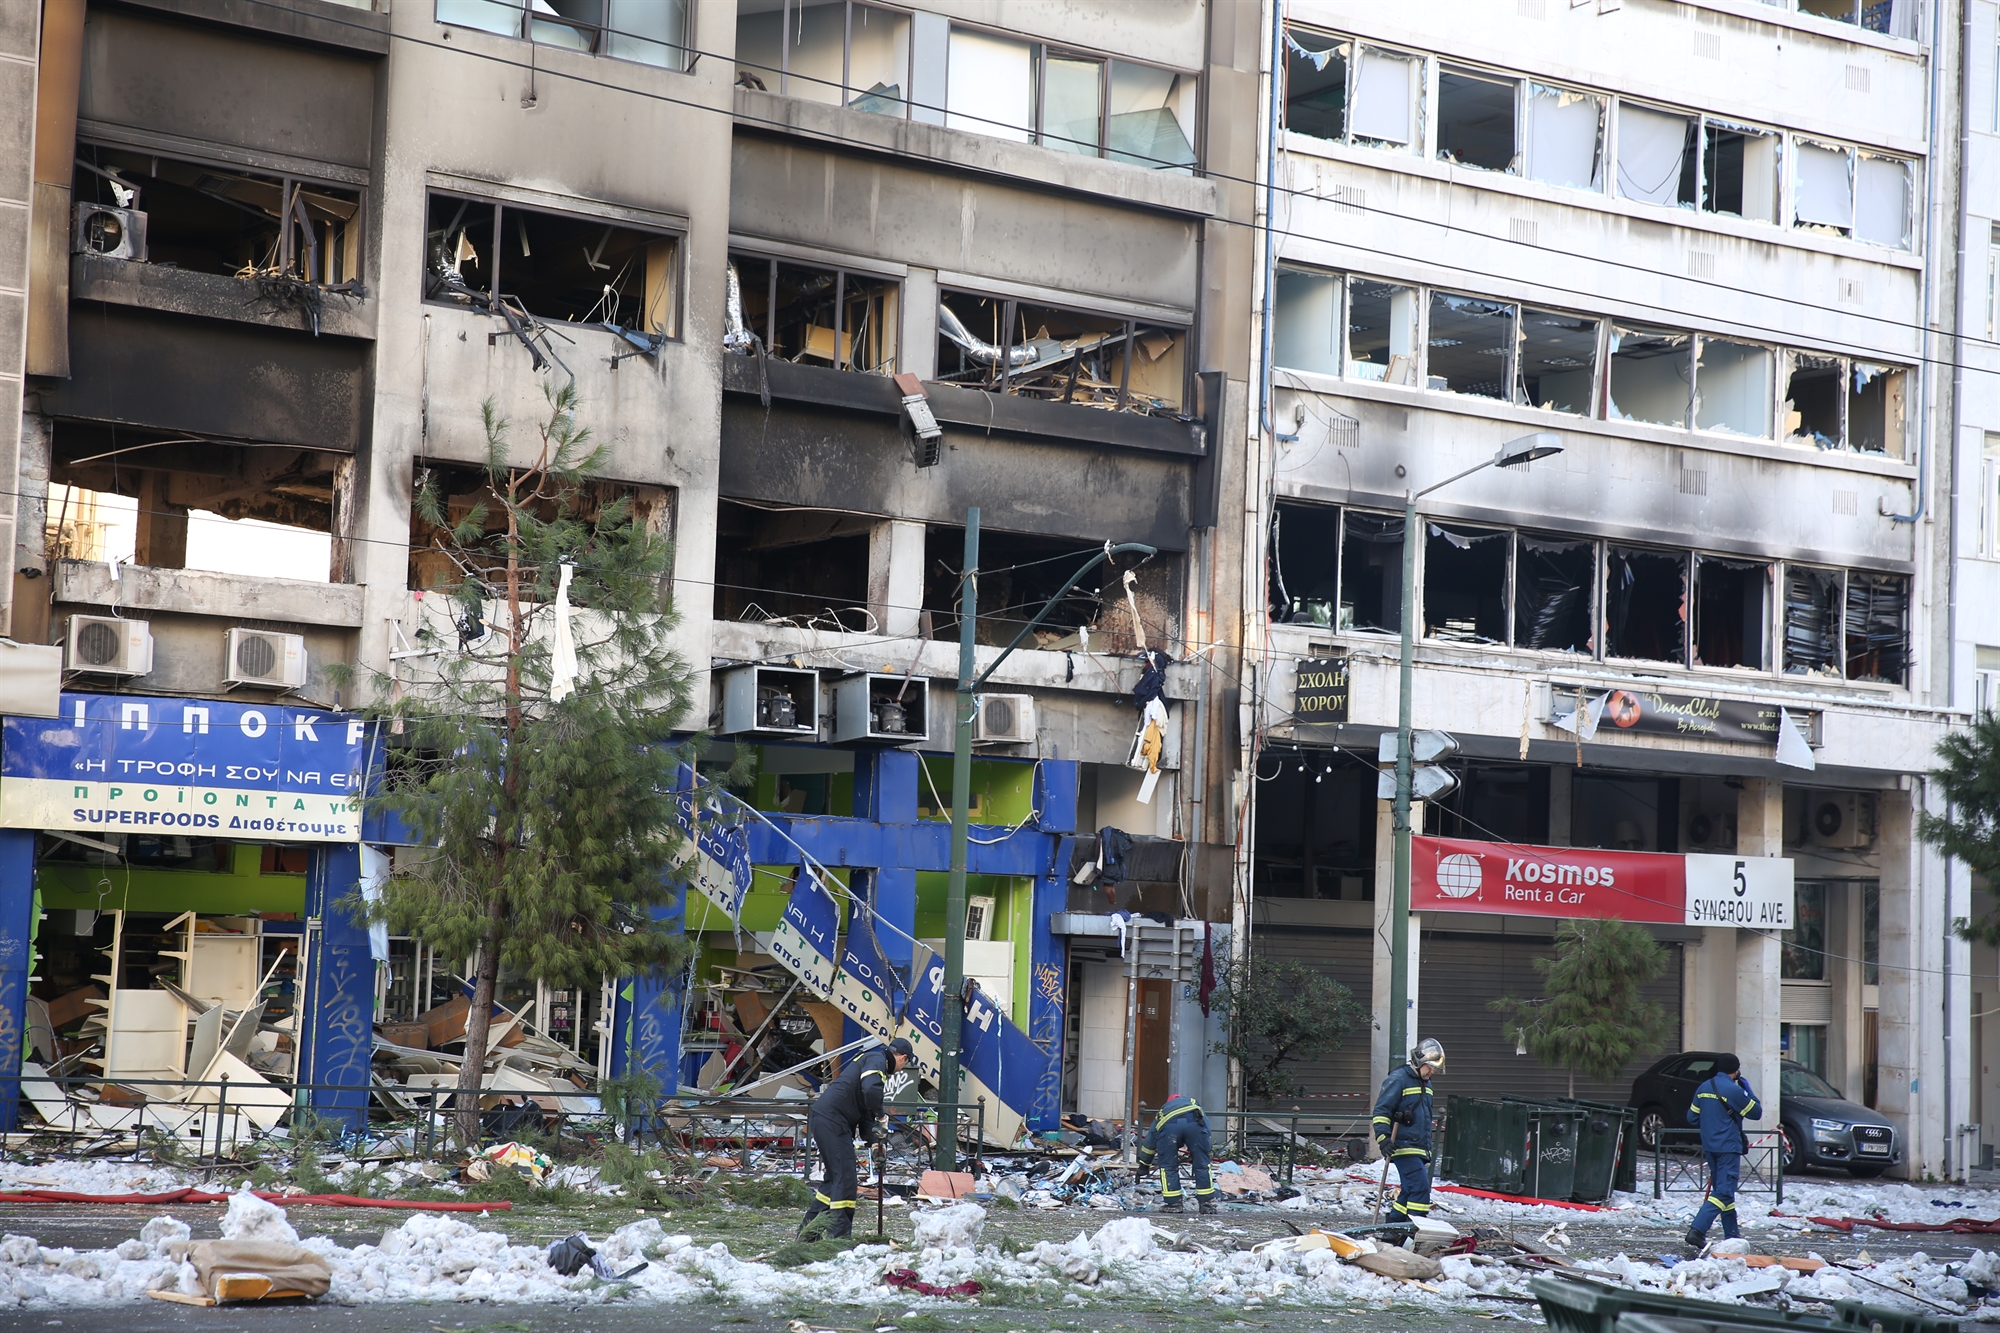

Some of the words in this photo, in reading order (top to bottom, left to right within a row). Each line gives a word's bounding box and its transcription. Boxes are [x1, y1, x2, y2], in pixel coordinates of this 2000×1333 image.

[1298, 671, 1345, 689] ΣΧΟΛΗ
[1298, 694, 1347, 712] ΧΟΡΟΥ
[1740, 721, 1779, 732] www.theda
[117, 759, 216, 778] ΤΡΟΦΗ
[225, 766, 278, 782] ΣΟΥ
[286, 768, 321, 785] ΝΑ
[74, 785, 305, 811] ΠΡΟΪΟΝΤΑ
[73, 808, 220, 828] SUPERFOODS
[228, 815, 347, 837] Διαθέτουμε
[1505, 858, 1615, 887] Kosmos
[1733, 861, 1746, 897] 5
[1505, 884, 1541, 902] Rent
[1544, 891, 1553, 902] a
[1558, 887, 1585, 904] Car
[1694, 899, 1753, 923] SYNGROU
[1760, 902, 1787, 924] AVE.
[773, 940, 801, 969] από
[840, 994, 858, 1014] τα
